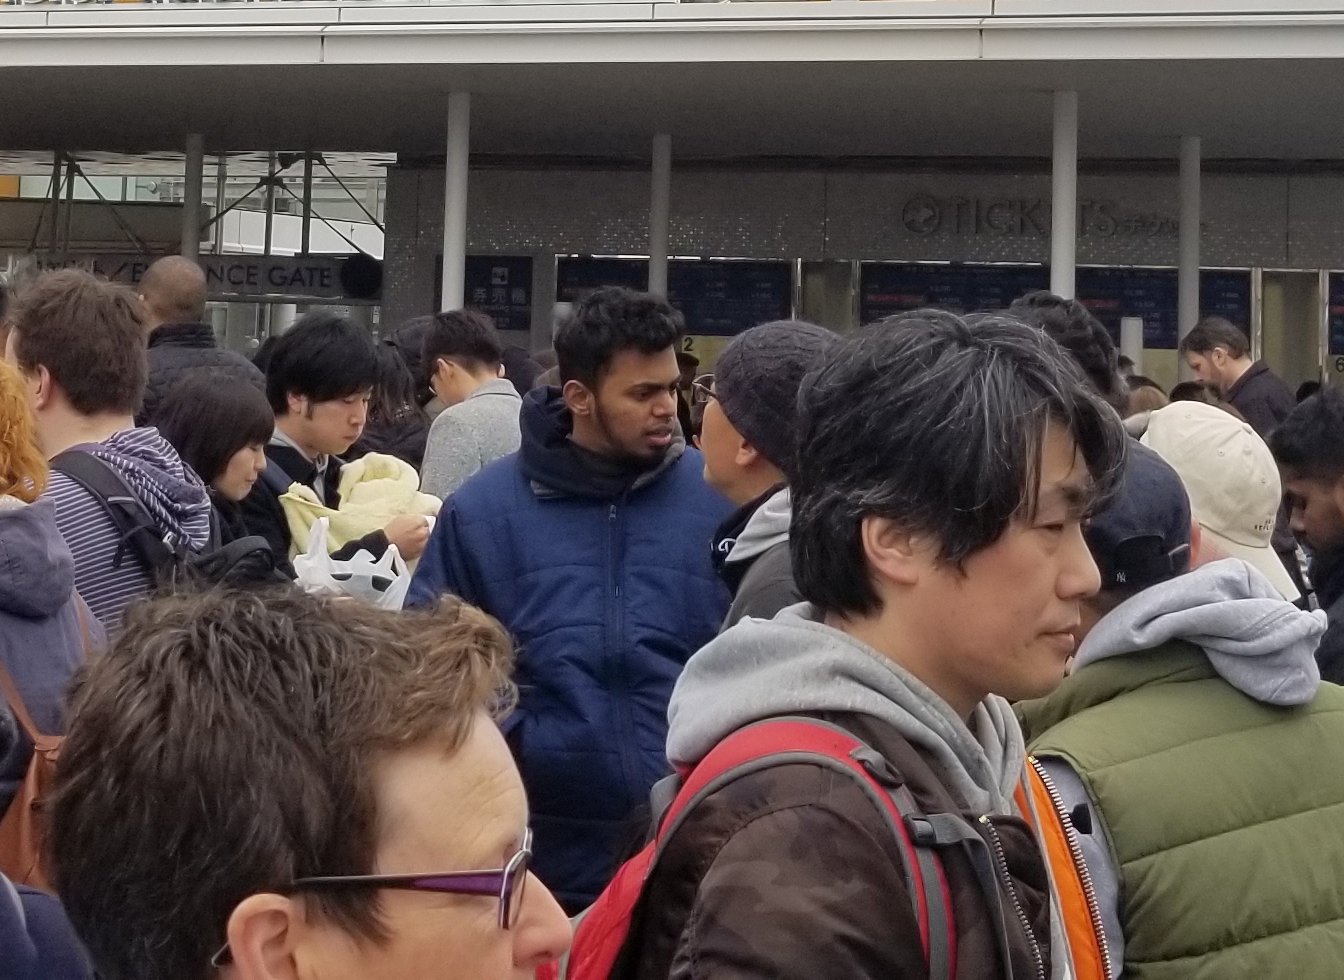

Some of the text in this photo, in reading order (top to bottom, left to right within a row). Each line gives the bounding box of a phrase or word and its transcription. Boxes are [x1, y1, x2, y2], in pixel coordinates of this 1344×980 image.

[954, 197, 1117, 236] TICKTS
[268, 265, 333, 288] GATE
[683, 336, 694, 352] 2
